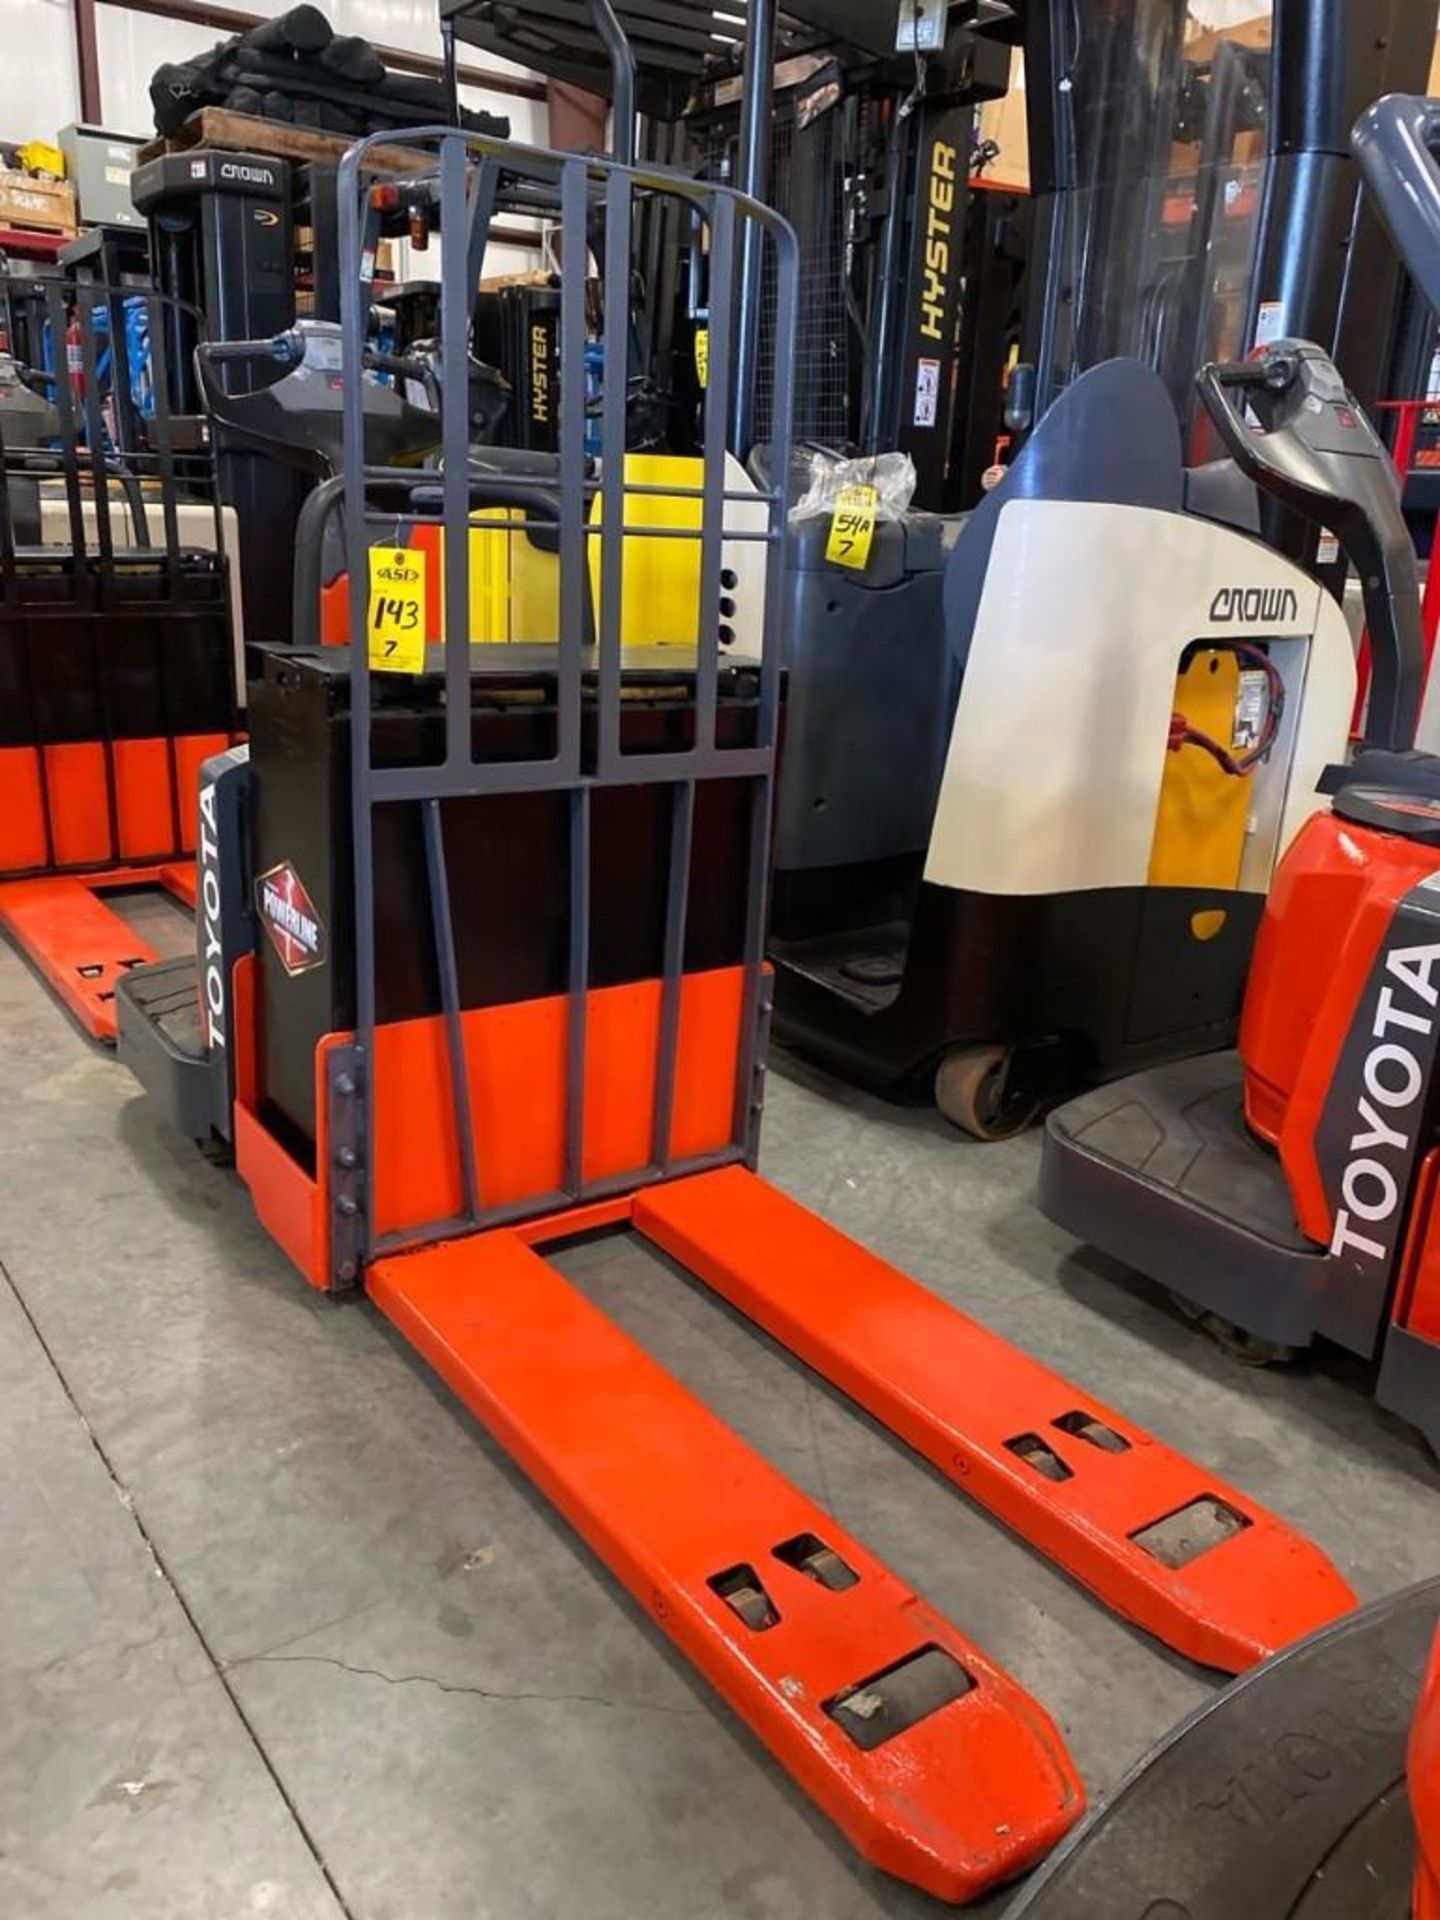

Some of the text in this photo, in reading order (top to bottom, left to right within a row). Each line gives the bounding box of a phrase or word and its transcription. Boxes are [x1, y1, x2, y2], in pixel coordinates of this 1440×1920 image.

[221, 163, 274, 185] CROWN
[920, 140, 956, 340] HYSTER
[532, 325, 548, 422] HYSTER
[839, 540, 854, 556] 7
[374, 597, 419, 630] 143
[1209, 588, 1297, 621] CROWN
[384, 640, 398, 658] 7
[199, 783, 225, 1049] TOYOTA
[1331, 943, 1440, 1260] TOYOTA
